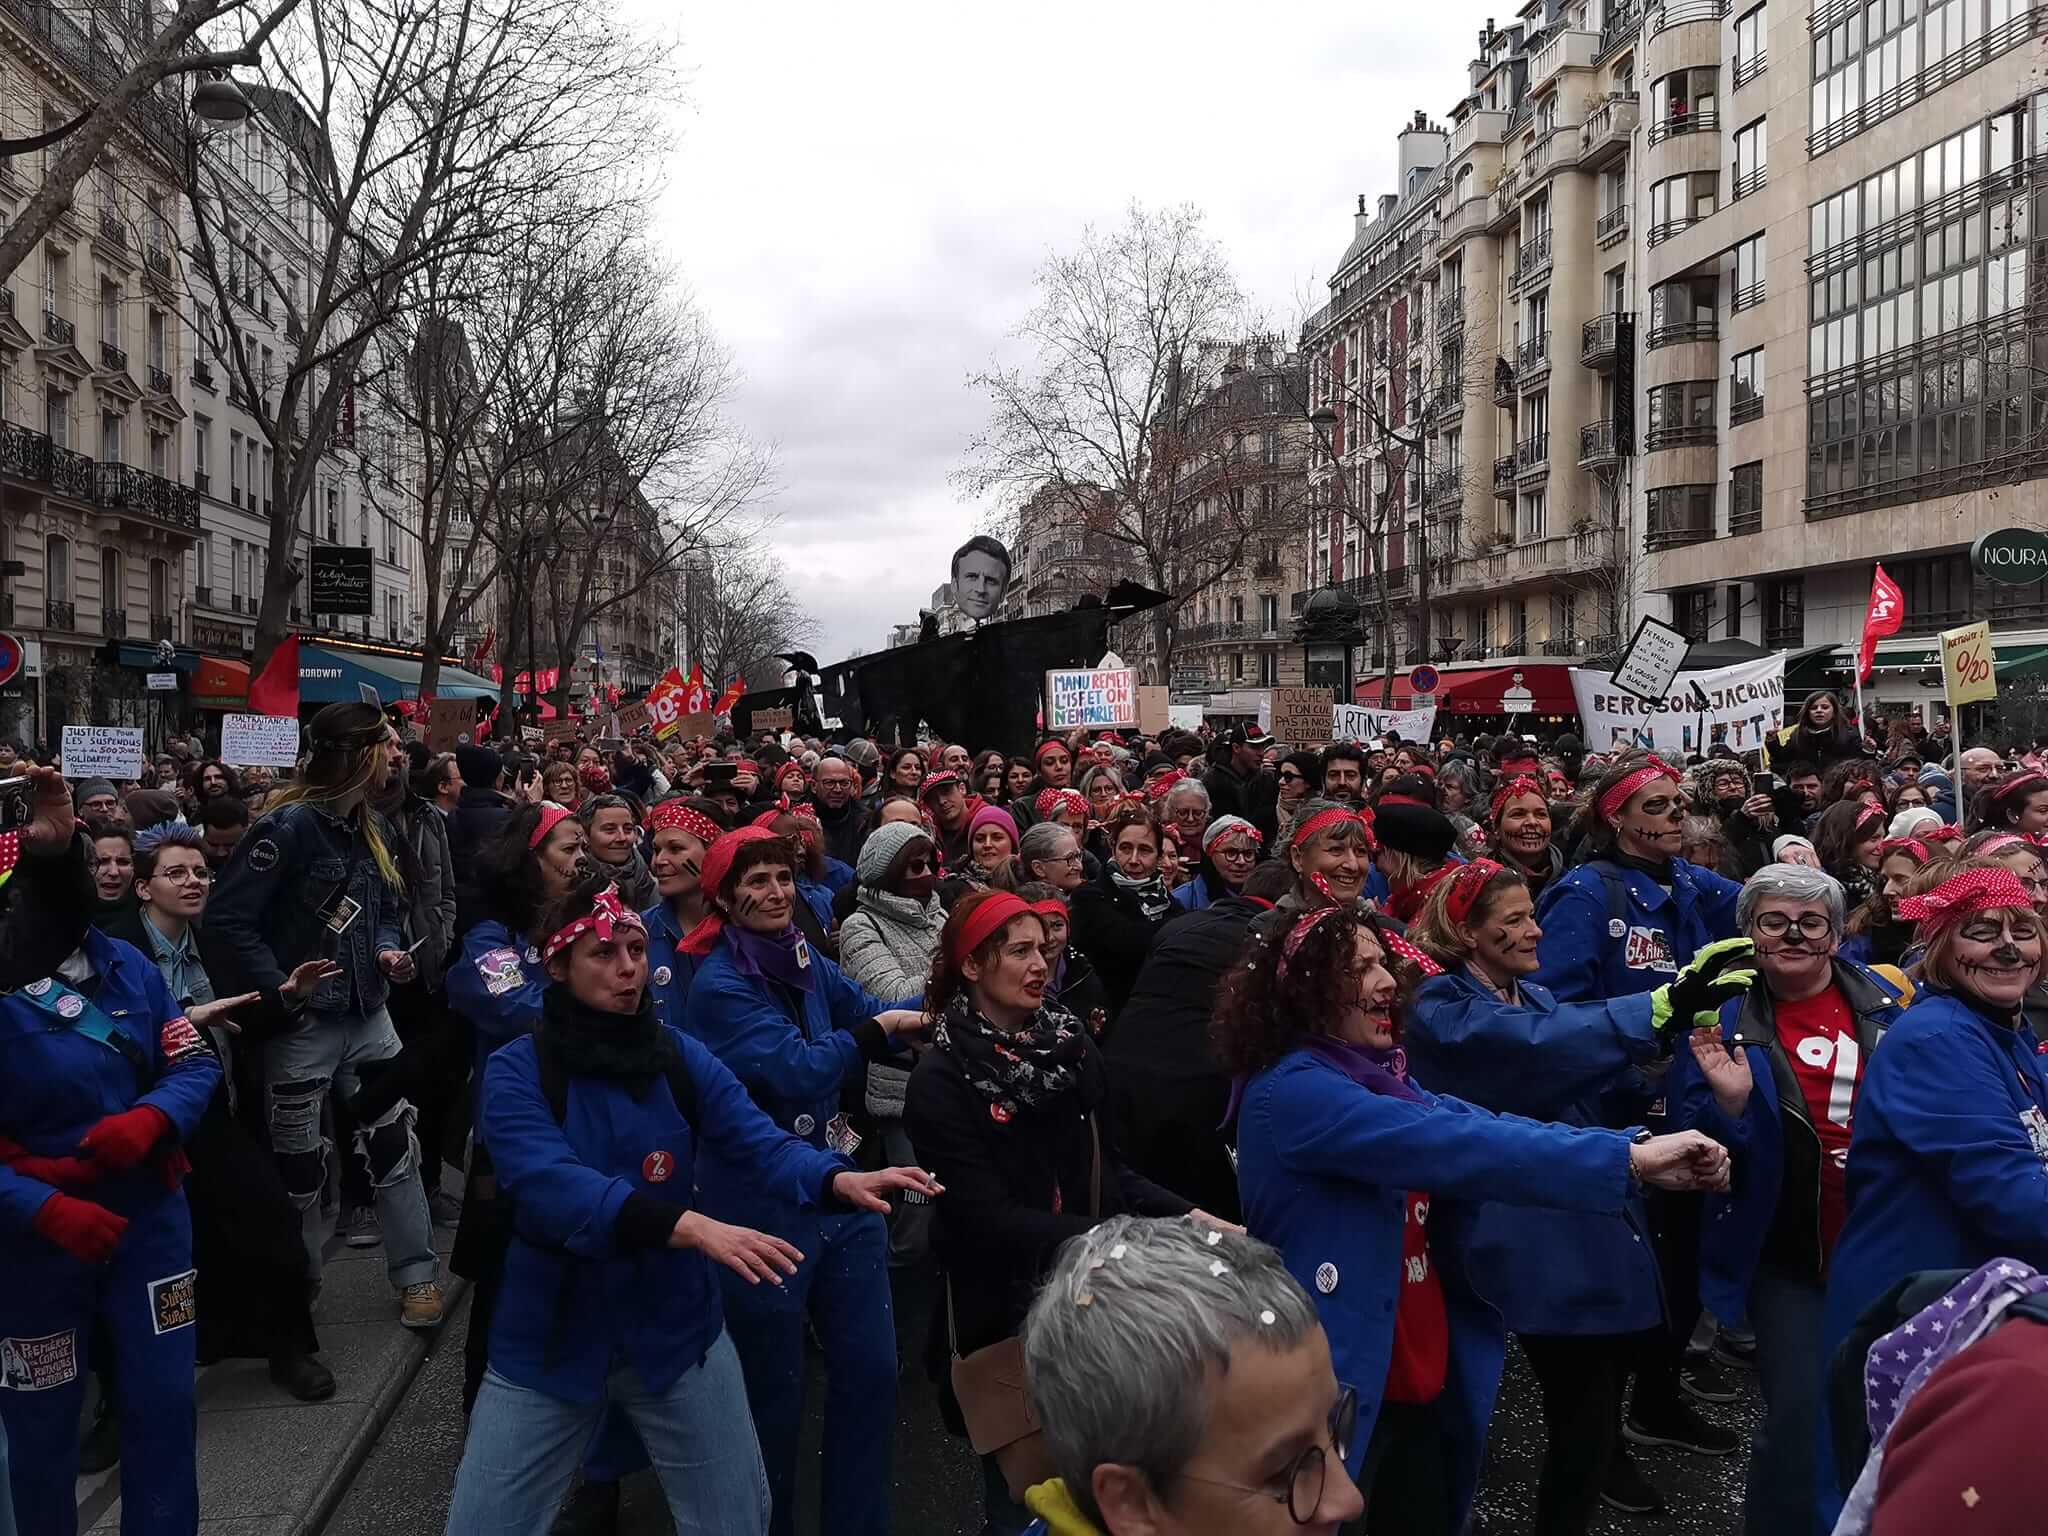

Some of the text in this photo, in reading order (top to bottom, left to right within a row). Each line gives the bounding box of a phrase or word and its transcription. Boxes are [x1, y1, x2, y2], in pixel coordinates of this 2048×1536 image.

[1984, 546, 2048, 566] NOURA
[1956, 642, 1989, 688] 0/20
[298, 668, 342, 679] ROADWAY
[1054, 674, 1091, 692] MANU
[1087, 689, 1102, 705] ET
[1106, 688, 1128, 704] ON
[1274, 689, 1321, 703] TOUCHE
[1286, 704, 1331, 714] TON CUL
[1593, 693, 1699, 716] BERGSON
[1275, 716, 1298, 728] PAS
[1311, 717, 1330, 727] NOS
[67, 727, 109, 737] JUSTICE
[1284, 728, 1333, 740] RETRAITES
[65, 736, 141, 747] LES SUSPENDUS
[100, 746, 117, 754] 500
